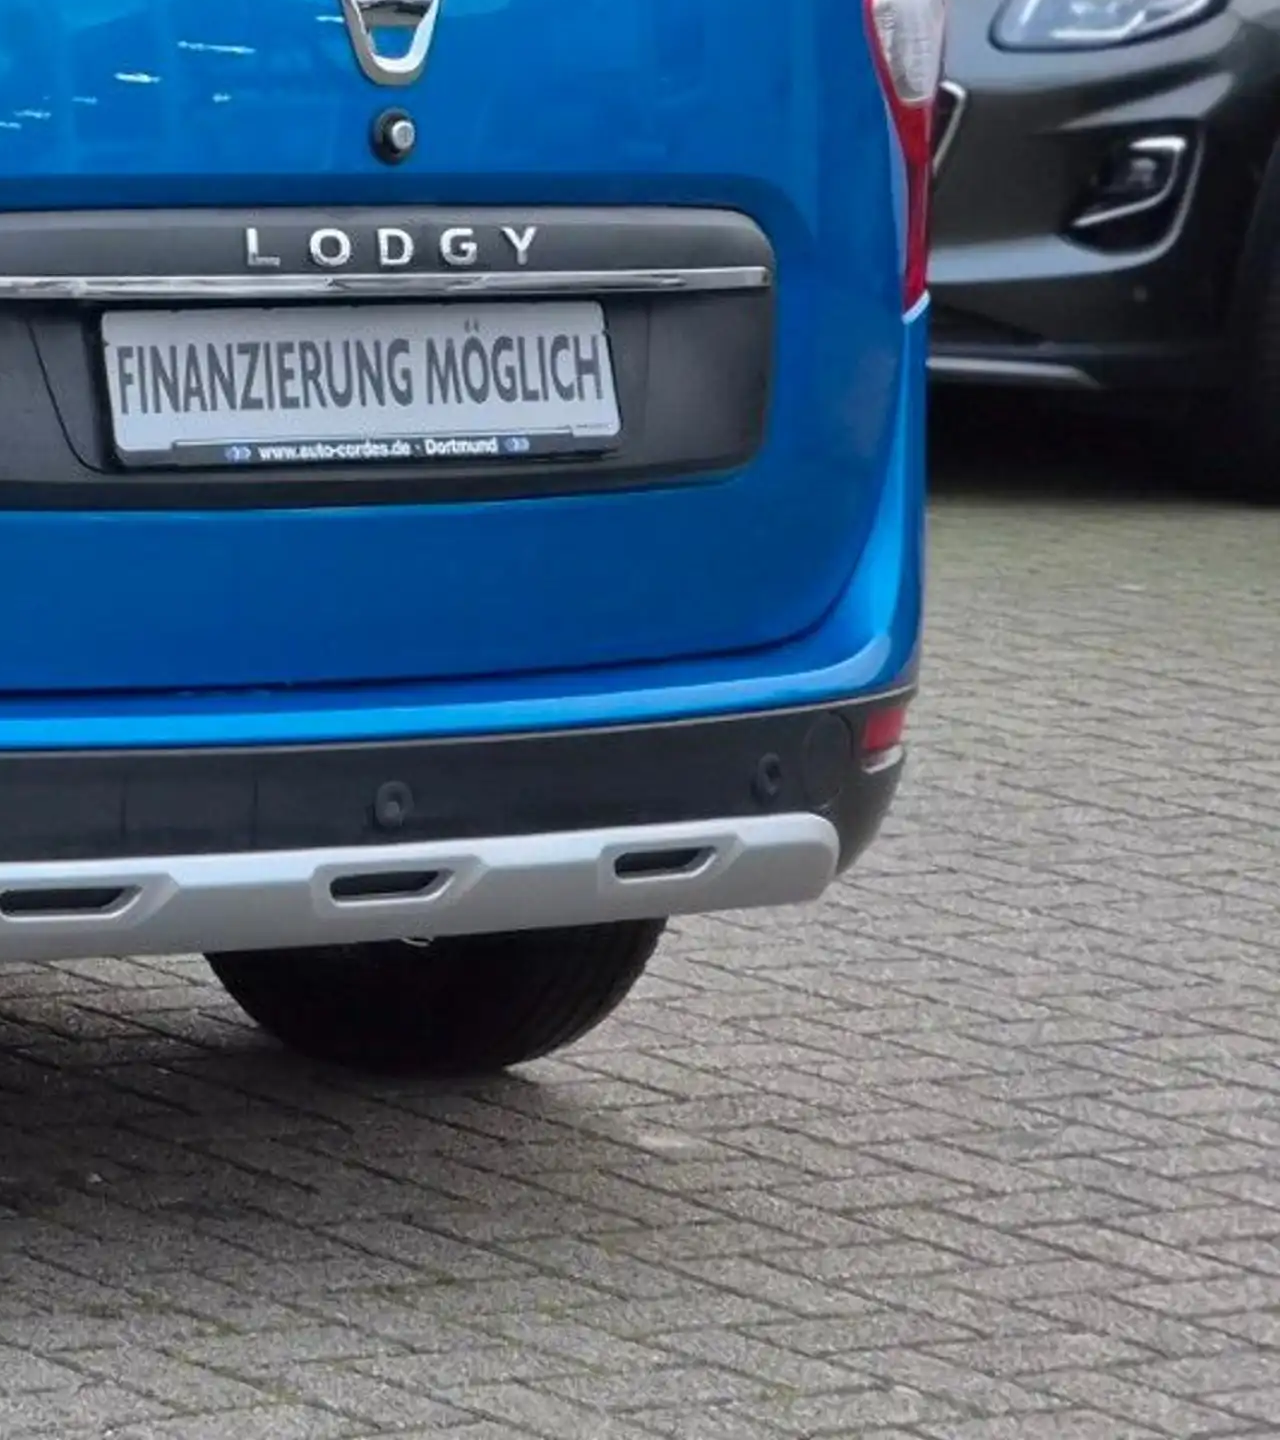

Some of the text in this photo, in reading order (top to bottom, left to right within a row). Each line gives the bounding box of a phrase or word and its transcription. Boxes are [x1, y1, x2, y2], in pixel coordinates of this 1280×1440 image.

[245, 226, 538, 267] LODGY
[116, 318, 605, 415] FINANZIERUNG MÖGLICH
[424, 436, 498, 455] Dortmund
